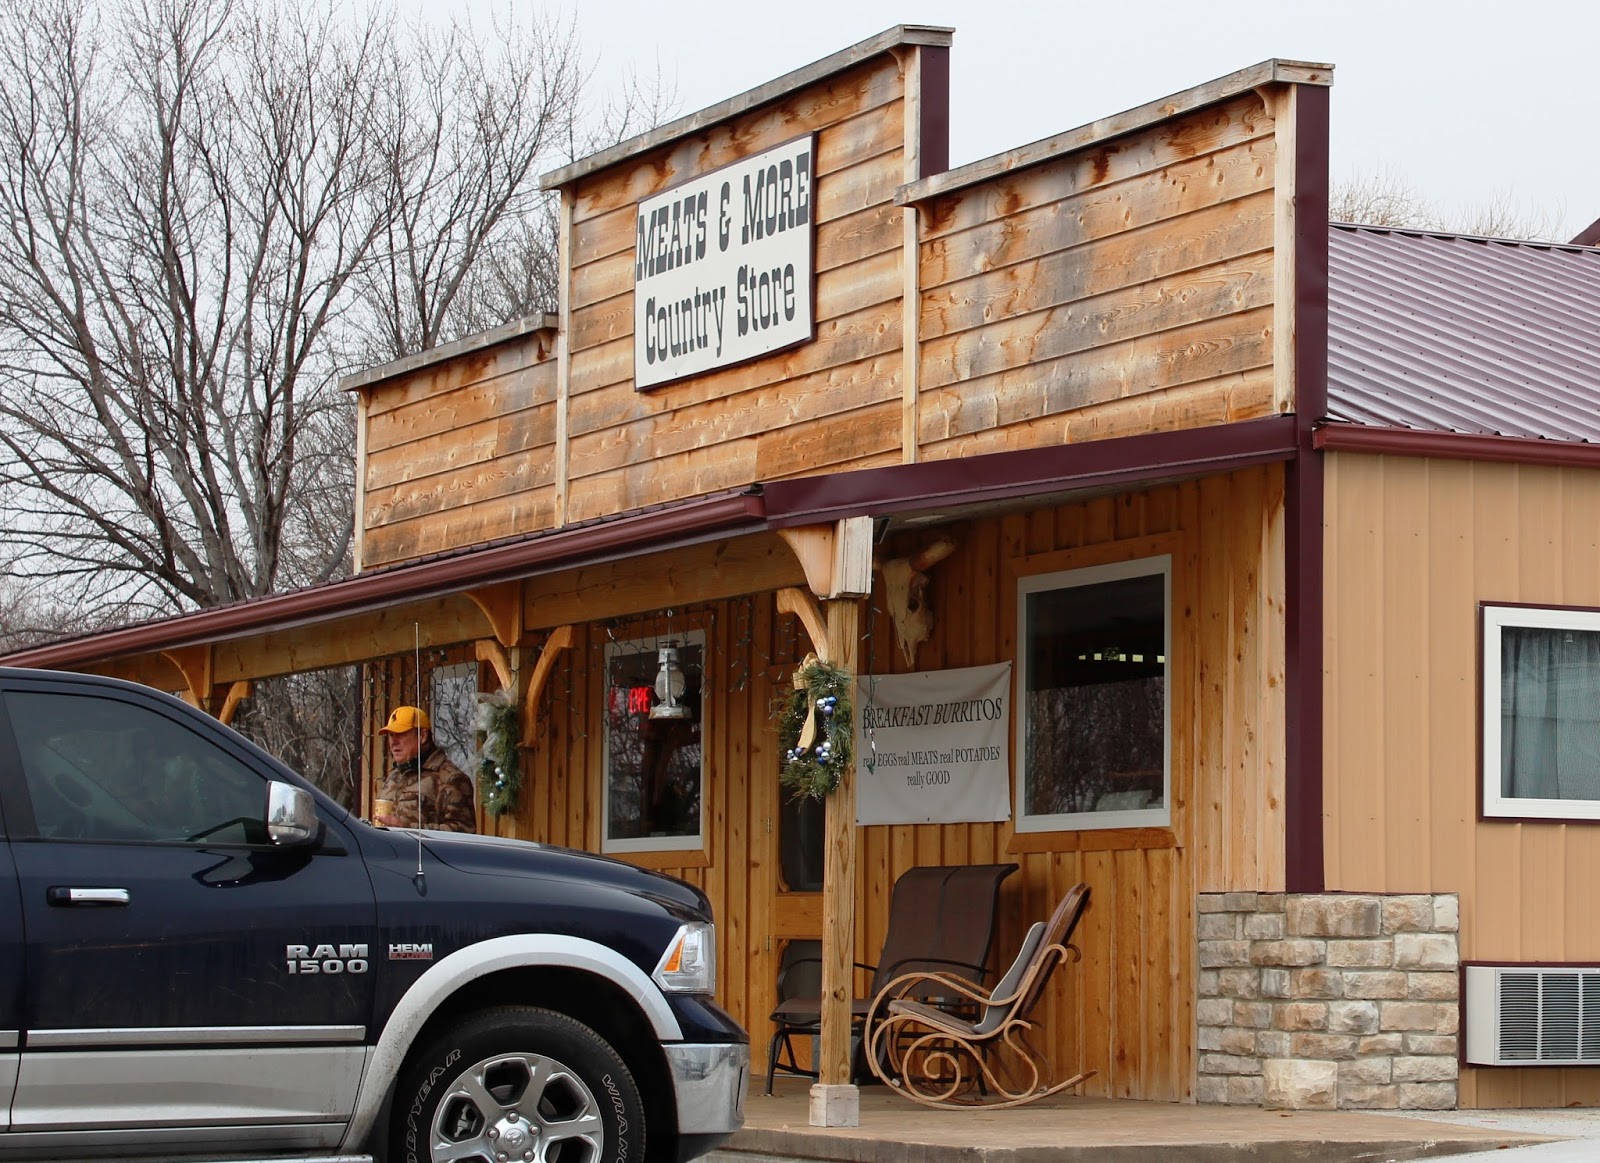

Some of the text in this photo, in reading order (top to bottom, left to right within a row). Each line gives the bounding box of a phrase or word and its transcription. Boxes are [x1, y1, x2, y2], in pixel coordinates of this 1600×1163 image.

[636, 151, 810, 282] MEATS & MORE
[646, 263, 796, 366] Country Store
[863, 698, 1002, 729] BREAKFAST BURRITOS
[877, 753, 898, 767] EGGS
[898, 751, 910, 766] real
[911, 750, 938, 765] MEATS
[940, 748, 954, 764] real
[955, 746, 1001, 763] POTATOES
[907, 770, 951, 789] really GOOD
[286, 944, 369, 959] RAM
[389, 944, 433, 952] HEMI
[287, 960, 369, 974] 1500
